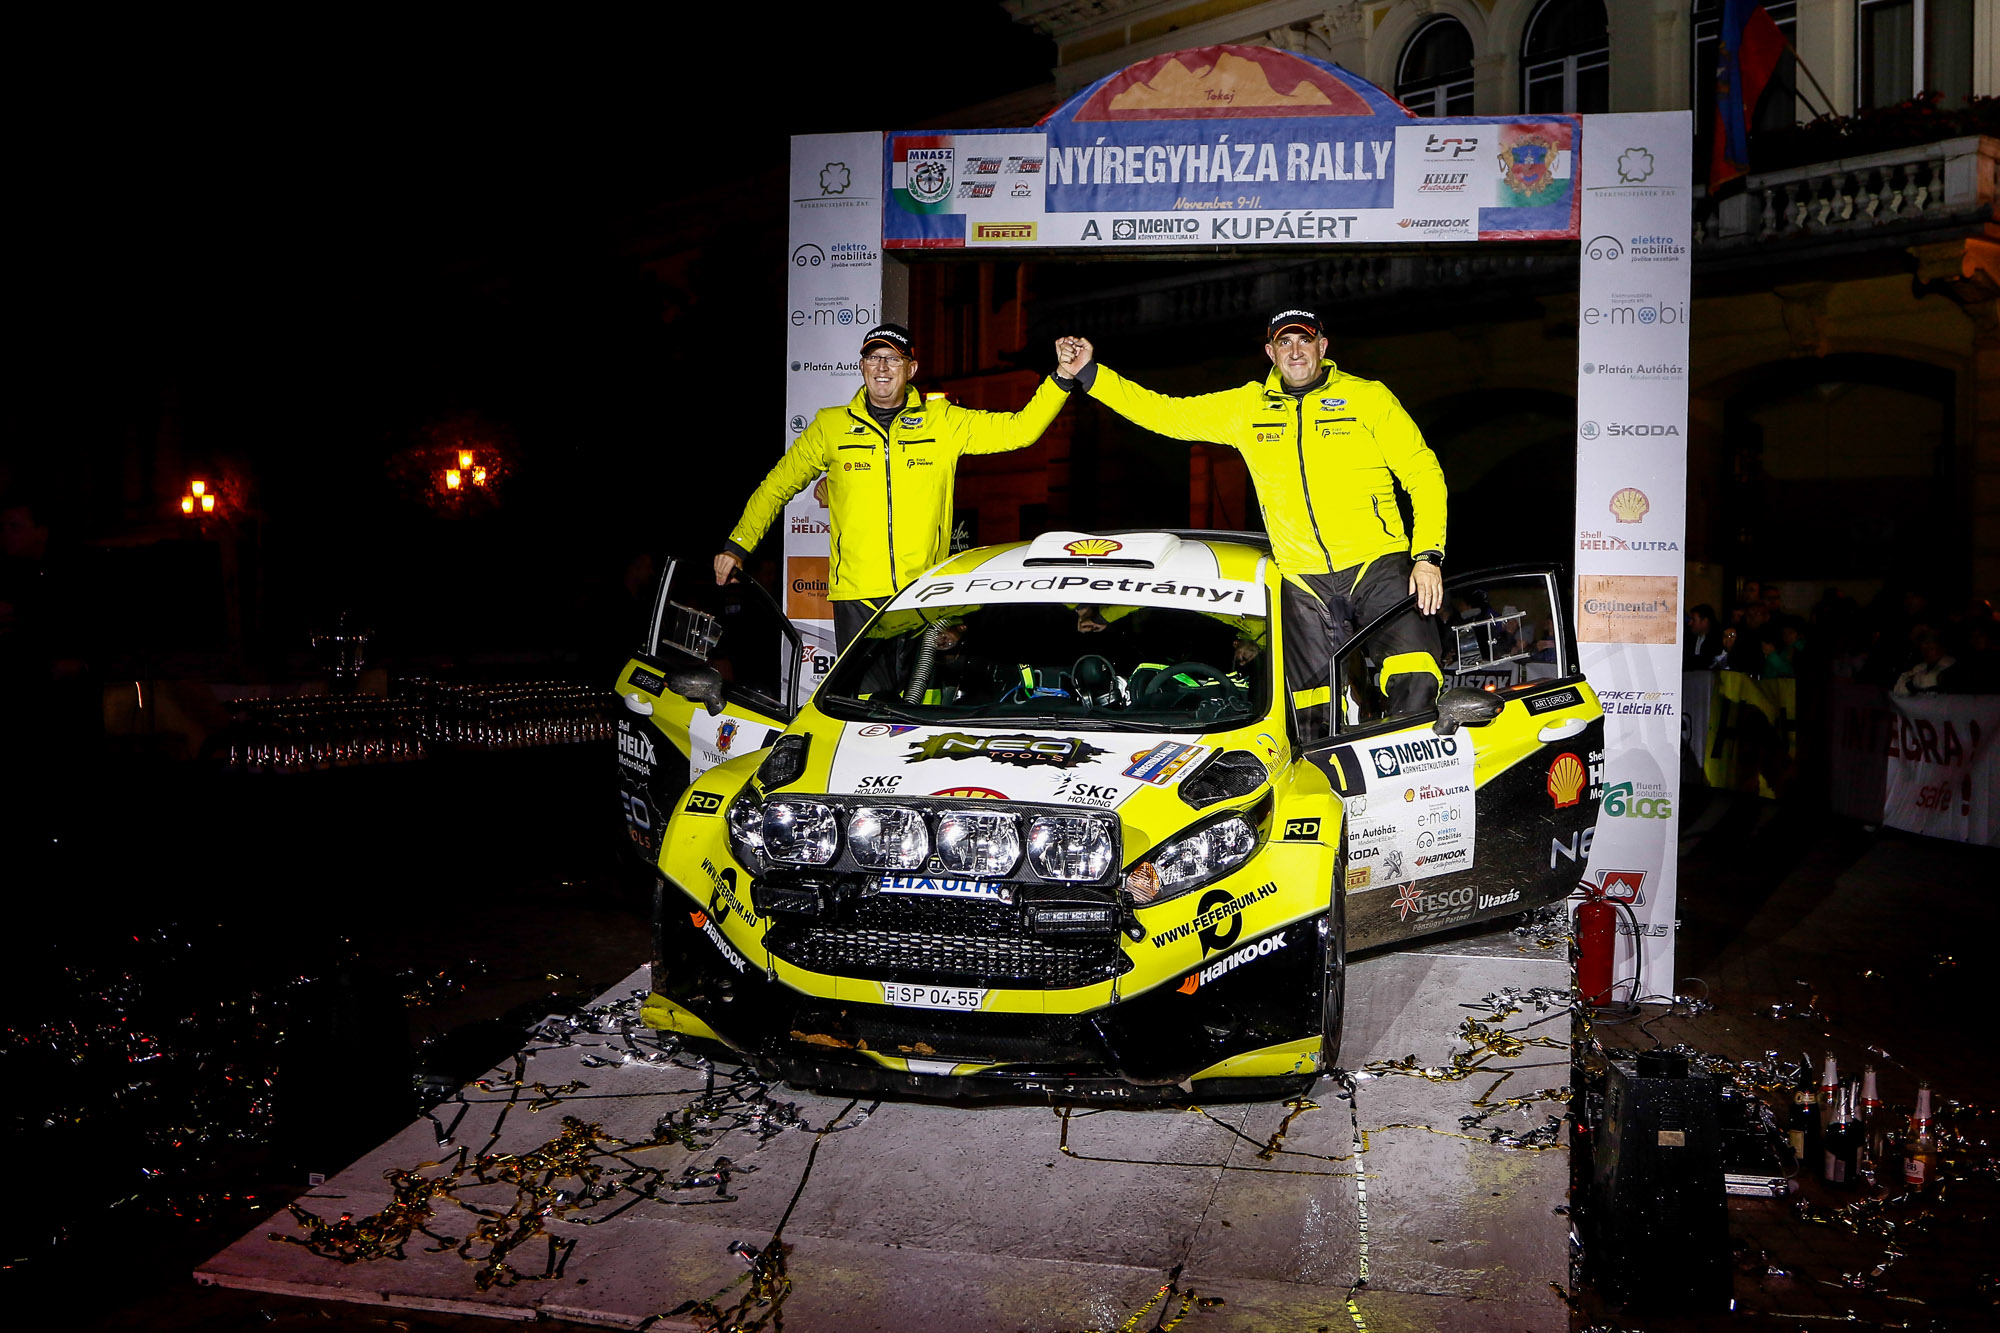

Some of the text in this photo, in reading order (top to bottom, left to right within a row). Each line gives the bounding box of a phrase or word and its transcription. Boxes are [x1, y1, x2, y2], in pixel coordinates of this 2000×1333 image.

[1204, 88, 1236, 102] Tokaj
[908, 150, 952, 160] MNASZ
[1049, 134, 1392, 185] NYÍREGYHÁZA RALLY
[1423, 173, 1468, 183] KELET
[1418, 182, 1467, 192] Autosport
[1172, 196, 1262, 210] November 9-11.
[978, 225, 1032, 238] PIRELLI
[1080, 220, 1102, 240] A
[1211, 210, 1358, 240] KUPÁÉRT
[1631, 235, 1673, 244] elektro
[831, 243, 867, 251] elektro
[1631, 244, 1685, 254] mobilitás
[831, 251, 877, 261] mobilitás
[804, 362, 833, 371] Platán
[1598, 364, 1683, 374] Platán Autóház
[1607, 422, 1680, 436] ŠKODA
[791, 516, 809, 524] Shell
[791, 522, 830, 534] HELIX
[1580, 531, 1602, 539] Shell
[1580, 538, 1679, 551] HELIX ULTRA
[965, 575, 1245, 604] FordPetrányi
[1584, 599, 1658, 614] Continental
[1617, 703, 1652, 715] Leticia
[1654, 704, 1674, 716] Kft.
[618, 719, 630, 732] Shell
[618, 731, 657, 766] HELIX
[942, 738, 1073, 755] NEO
[988, 751, 1064, 763] TOOLS
[618, 753, 651, 776] Motorolajok
[1328, 752, 1348, 792] 1
[858, 775, 903, 788] SKC
[1419, 784, 1431, 792] Shell
[1636, 782, 1662, 790] fluent
[854, 787, 895, 795] HOLDING
[1072, 783, 1118, 799] SKC
[1420, 785, 1470, 800] HELIX ULTRA
[1636, 790, 1672, 798] solutions
[687, 794, 720, 809] RD
[1068, 795, 1112, 808] HOLDING
[1285, 822, 1319, 835] RD
[1362, 824, 1397, 838] Autóház
[1437, 827, 1457, 836] elektro
[1437, 832, 1462, 842] mobilitás
[700, 857, 758, 928] WWW.FEFERRUM.HU
[1478, 888, 1521, 910] Utazás
[1414, 887, 1474, 913] TESCO
[1151, 881, 1278, 949] WWW.FEFERRUM.HU
[1412, 913, 1471, 932] Pénzügyi Partner
[887, 987, 979, 1007] H SP 04-55
